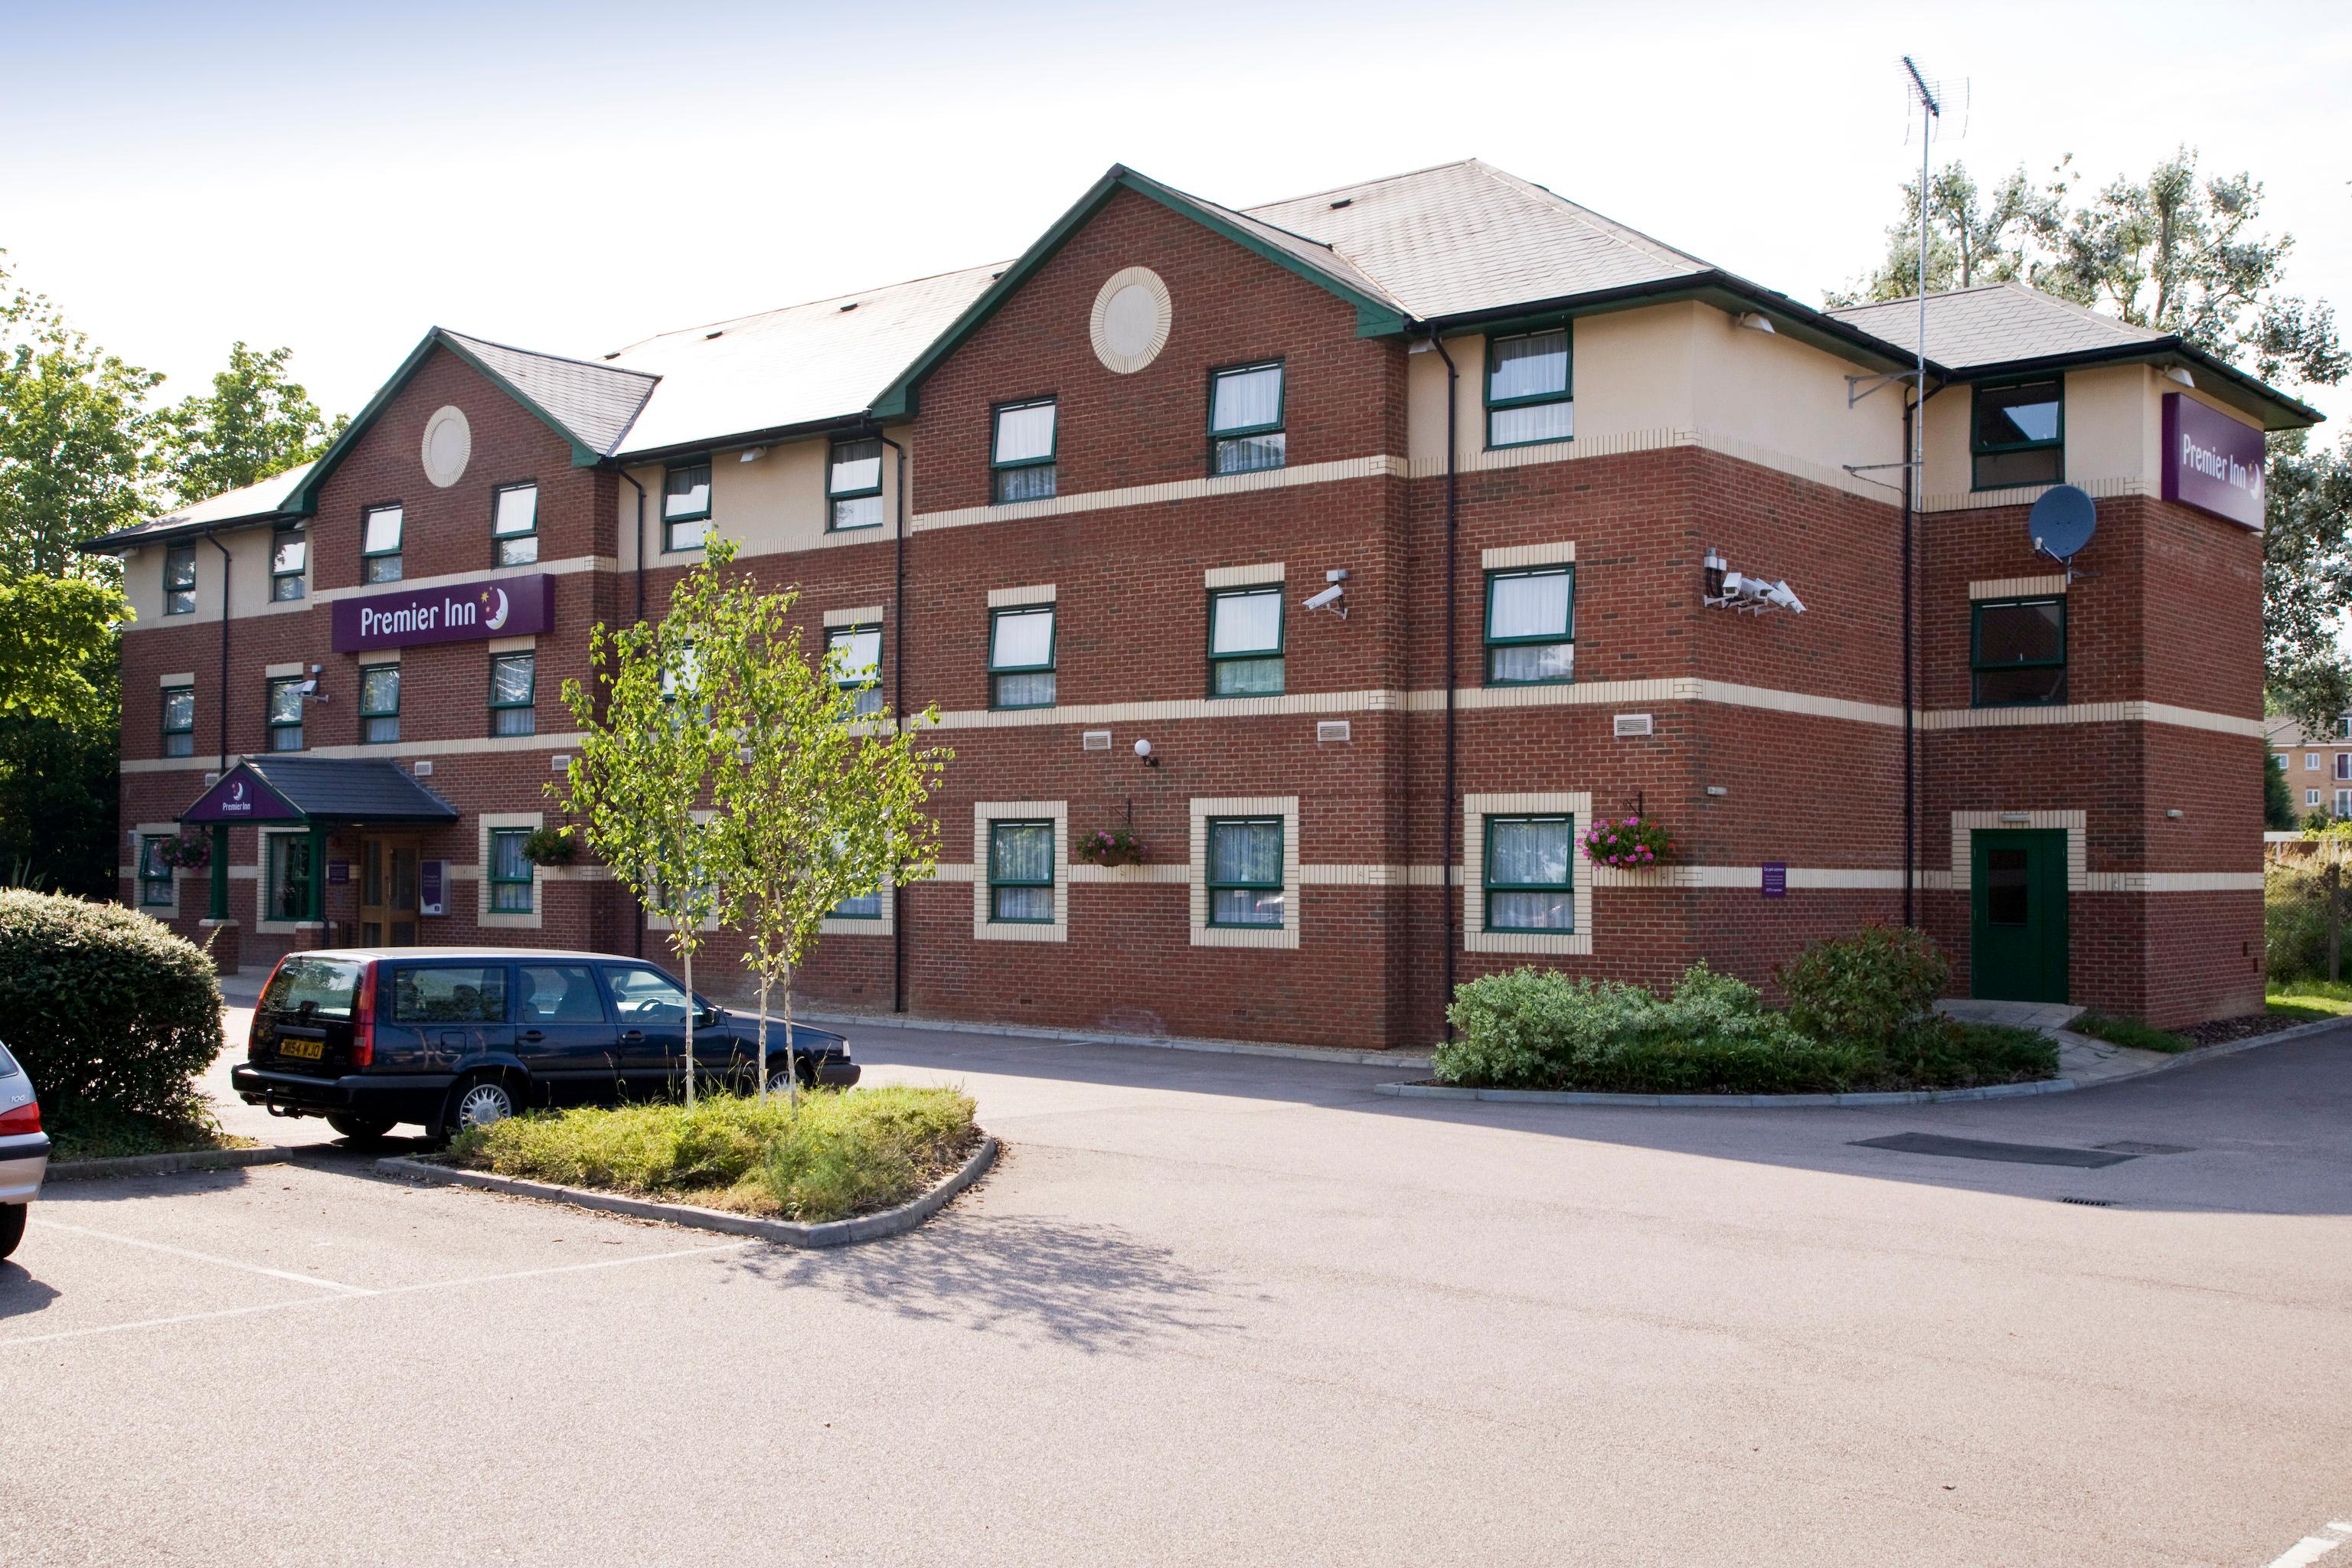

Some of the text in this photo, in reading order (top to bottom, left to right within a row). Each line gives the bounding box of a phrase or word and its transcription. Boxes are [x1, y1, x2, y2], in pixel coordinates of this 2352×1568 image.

[2183, 433, 2246, 489] Premier Inn
[361, 598, 475, 636] Premier Inn
[223, 802, 251, 811] Premier Inn
[11, 1094, 25, 1102] 106
